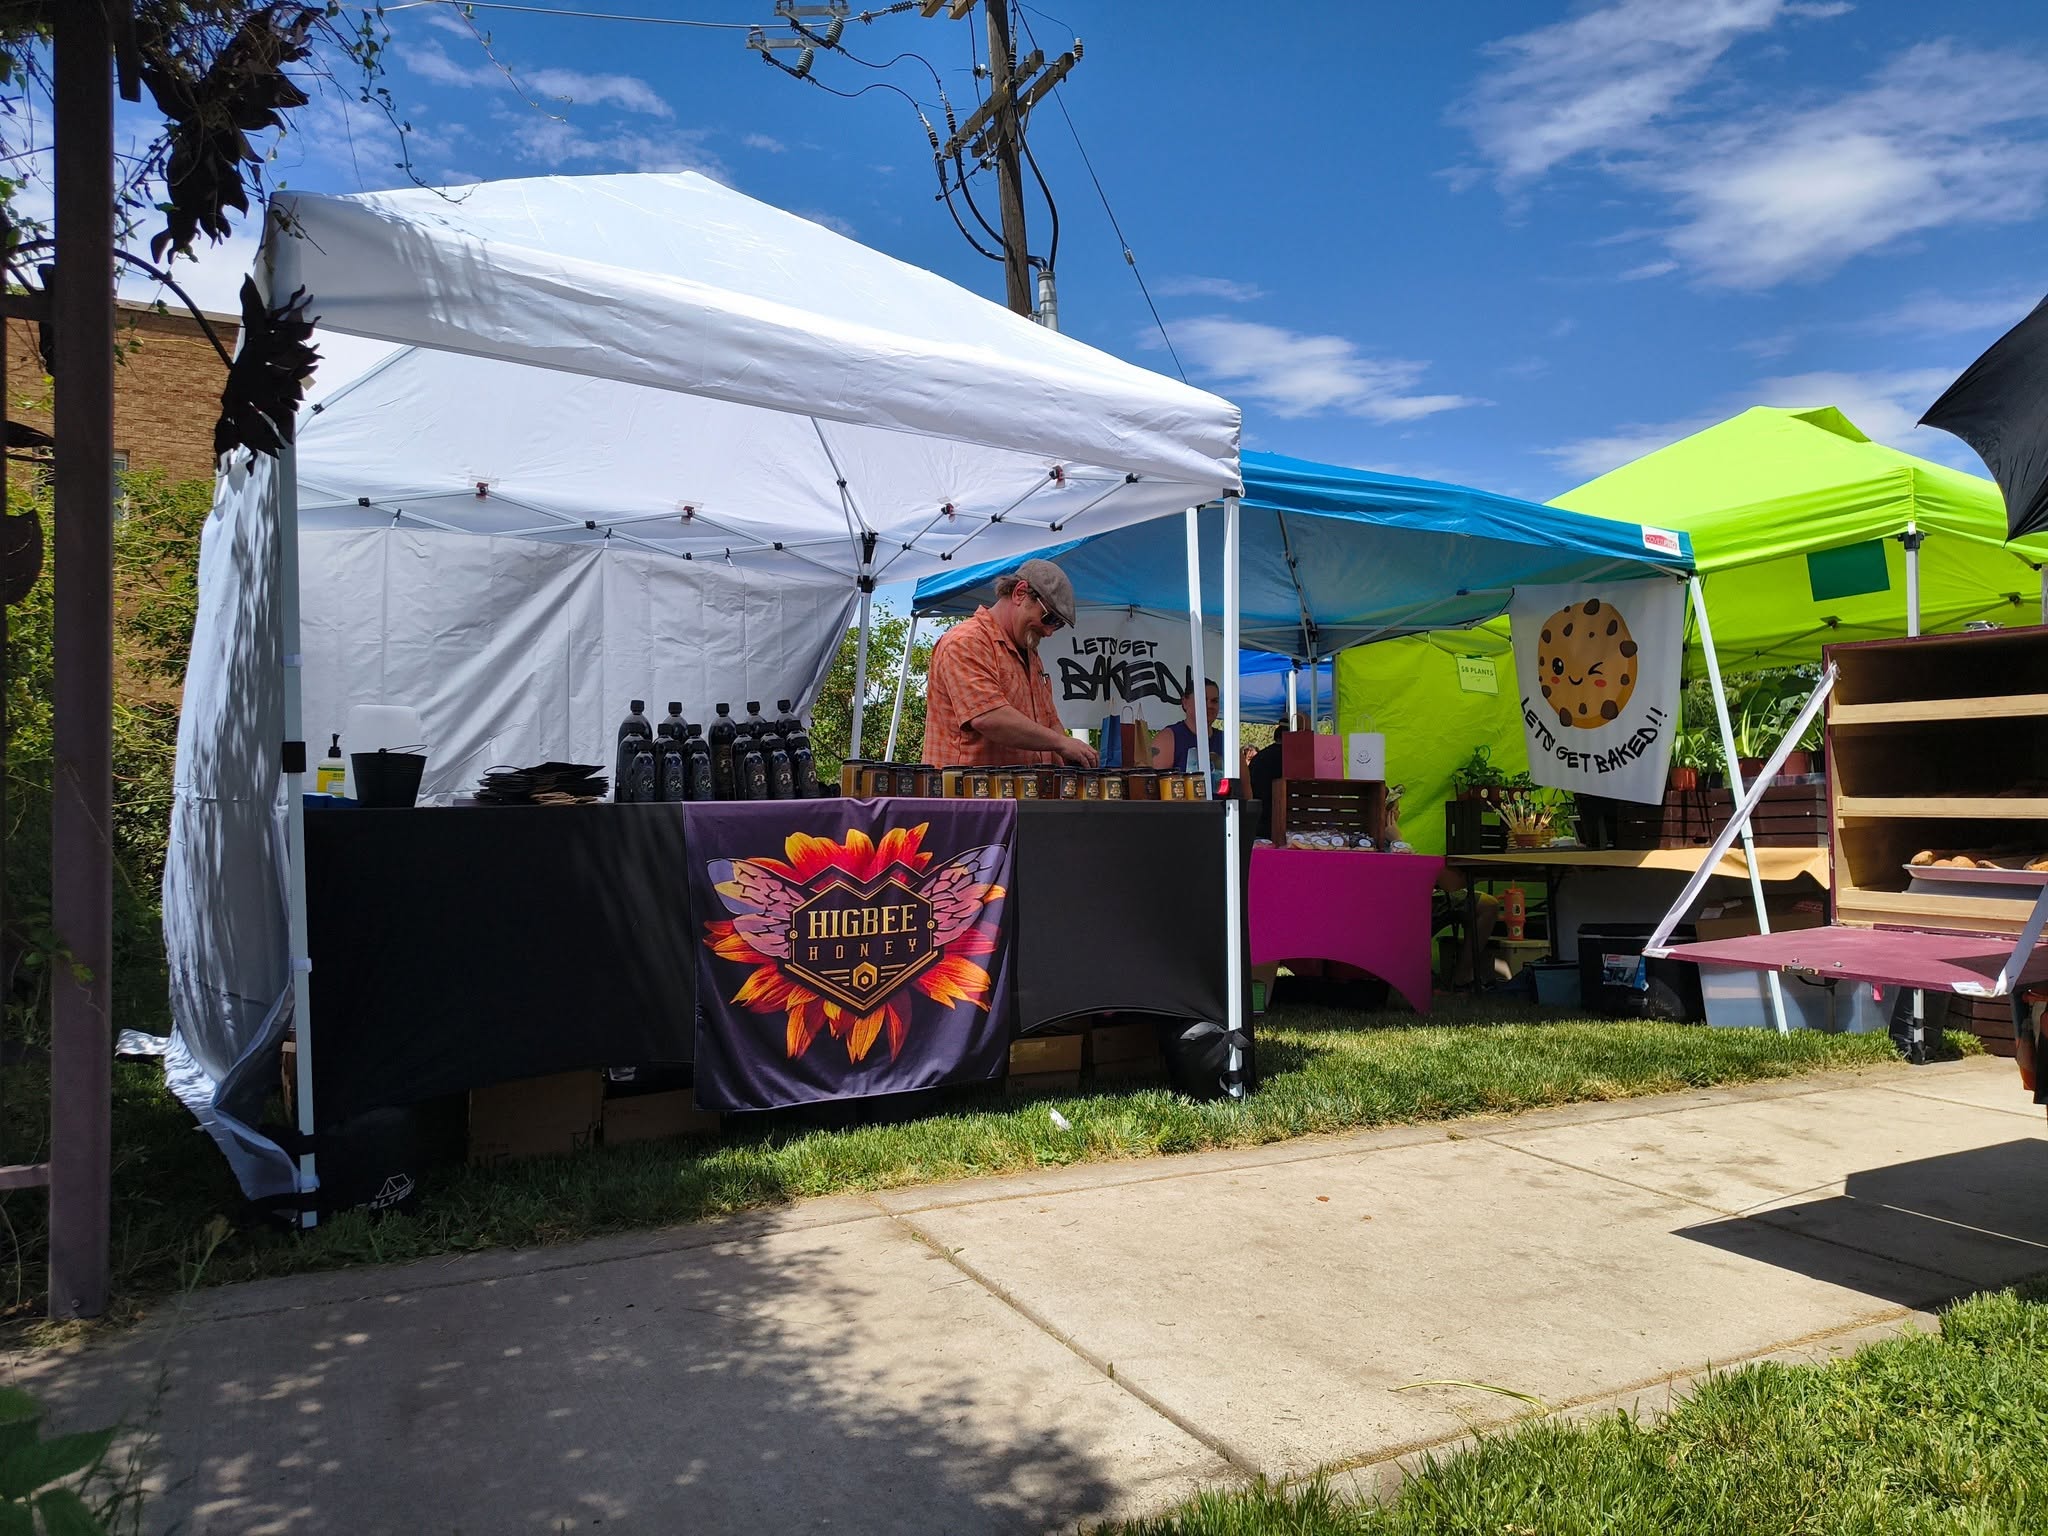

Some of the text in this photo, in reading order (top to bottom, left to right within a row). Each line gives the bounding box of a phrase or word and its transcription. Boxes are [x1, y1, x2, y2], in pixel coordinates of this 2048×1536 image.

[1119, 639, 1158, 658] GET
[1556, 745, 1591, 773] GET
[807, 903, 918, 939] HIGBEE
[808, 938, 917, 961] HONEY
